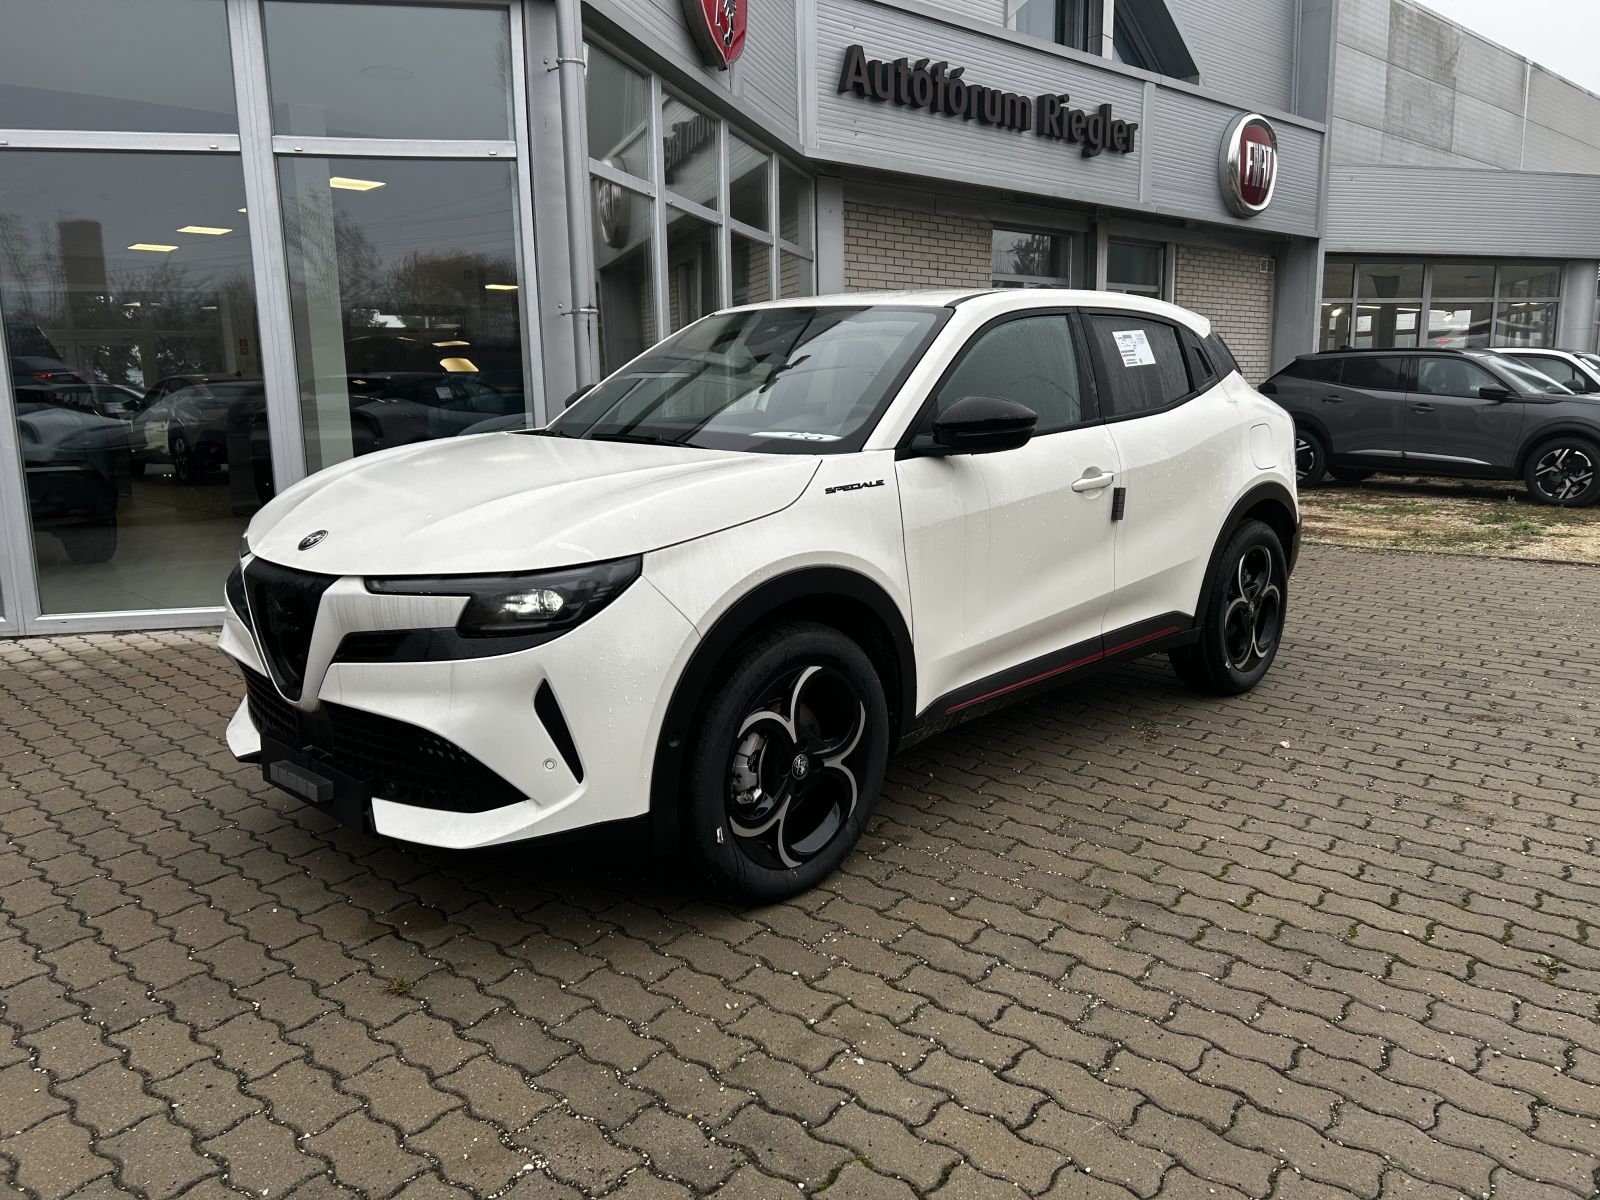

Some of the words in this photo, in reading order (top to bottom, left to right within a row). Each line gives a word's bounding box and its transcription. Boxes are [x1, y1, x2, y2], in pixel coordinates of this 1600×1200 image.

[838, 44, 1032, 132] Autófórum
[1037, 93, 1138, 157] Riegler
[1244, 140, 1272, 189] FIAT
[825, 479, 885, 494] SPECIALE
